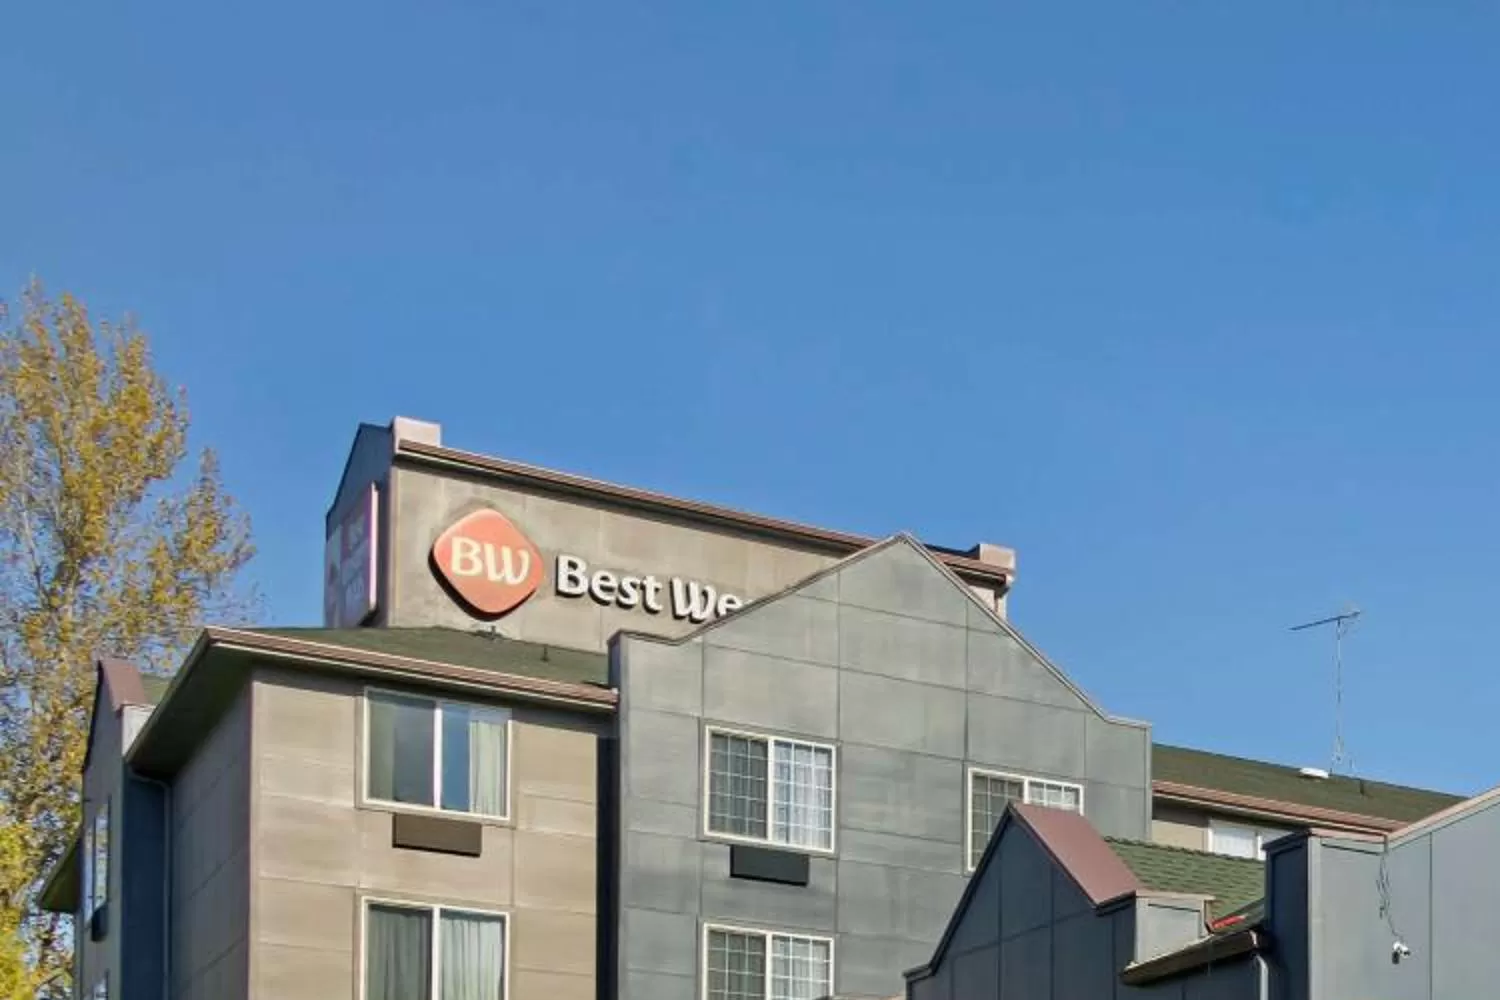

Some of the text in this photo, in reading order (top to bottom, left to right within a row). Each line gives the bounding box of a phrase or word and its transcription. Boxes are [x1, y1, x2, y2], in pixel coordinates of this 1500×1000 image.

[451, 537, 529, 585] BW
[556, 555, 752, 621] Best We
